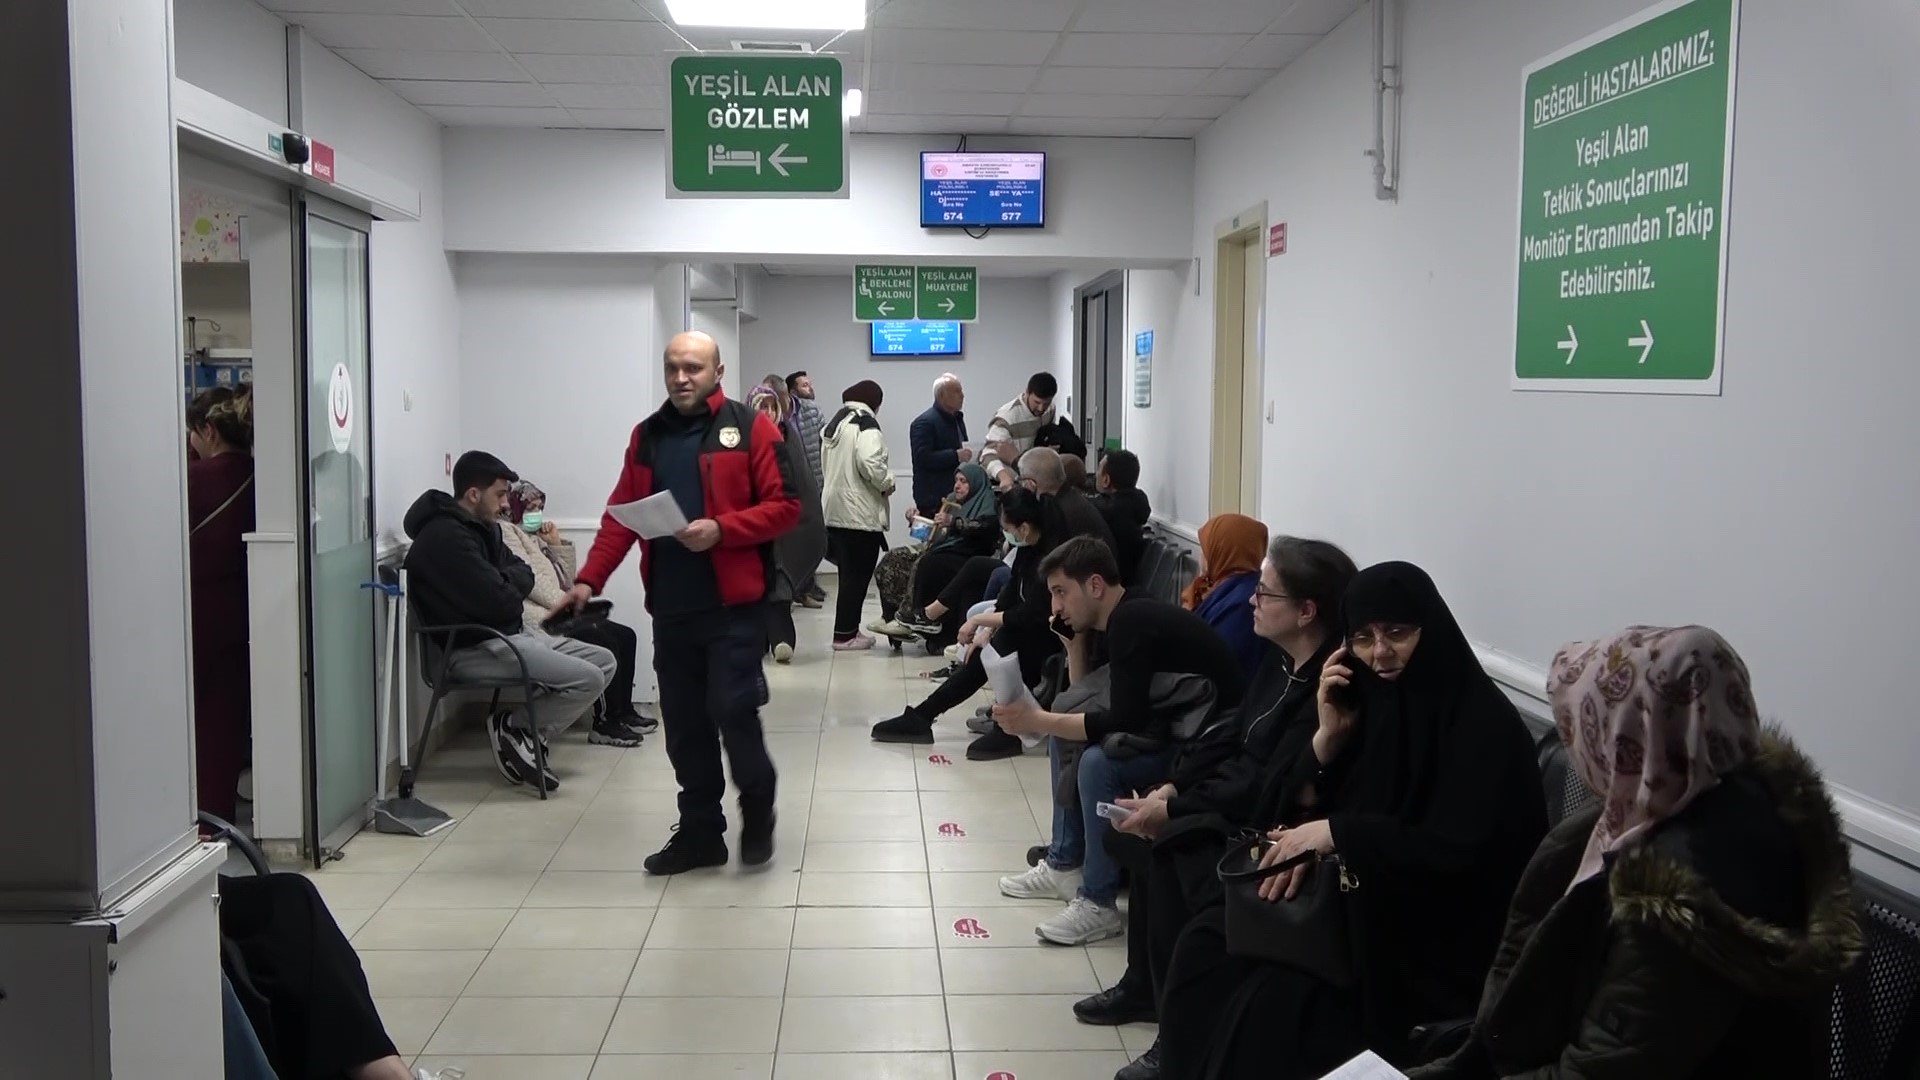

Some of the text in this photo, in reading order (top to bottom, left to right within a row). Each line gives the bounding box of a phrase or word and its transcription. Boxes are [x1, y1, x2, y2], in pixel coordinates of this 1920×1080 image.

[684, 69, 831, 99] YEŞİL ALAN
[1533, 29, 1715, 125] DEĞERLİ HASTALARIMIZ;
[707, 102, 809, 129] GÖZLEM
[1575, 123, 1649, 168] Yeşil Alan
[1543, 161, 1690, 218] Tetkik Sonuçlarınızı
[943, 212, 963, 221] 574
[1001, 212, 1022, 221] 577
[1523, 200, 1714, 263] Monitör Ekranından Takip
[861, 267, 912, 277] YEŞİL ALAN
[921, 270, 972, 281] YEŞİL ALAN
[1560, 259, 1656, 299] Edebilirsiniz.
[869, 279, 912, 288] BEKLEME
[925, 283, 969, 292] MUAYENE
[876, 291, 912, 299] SALONU
